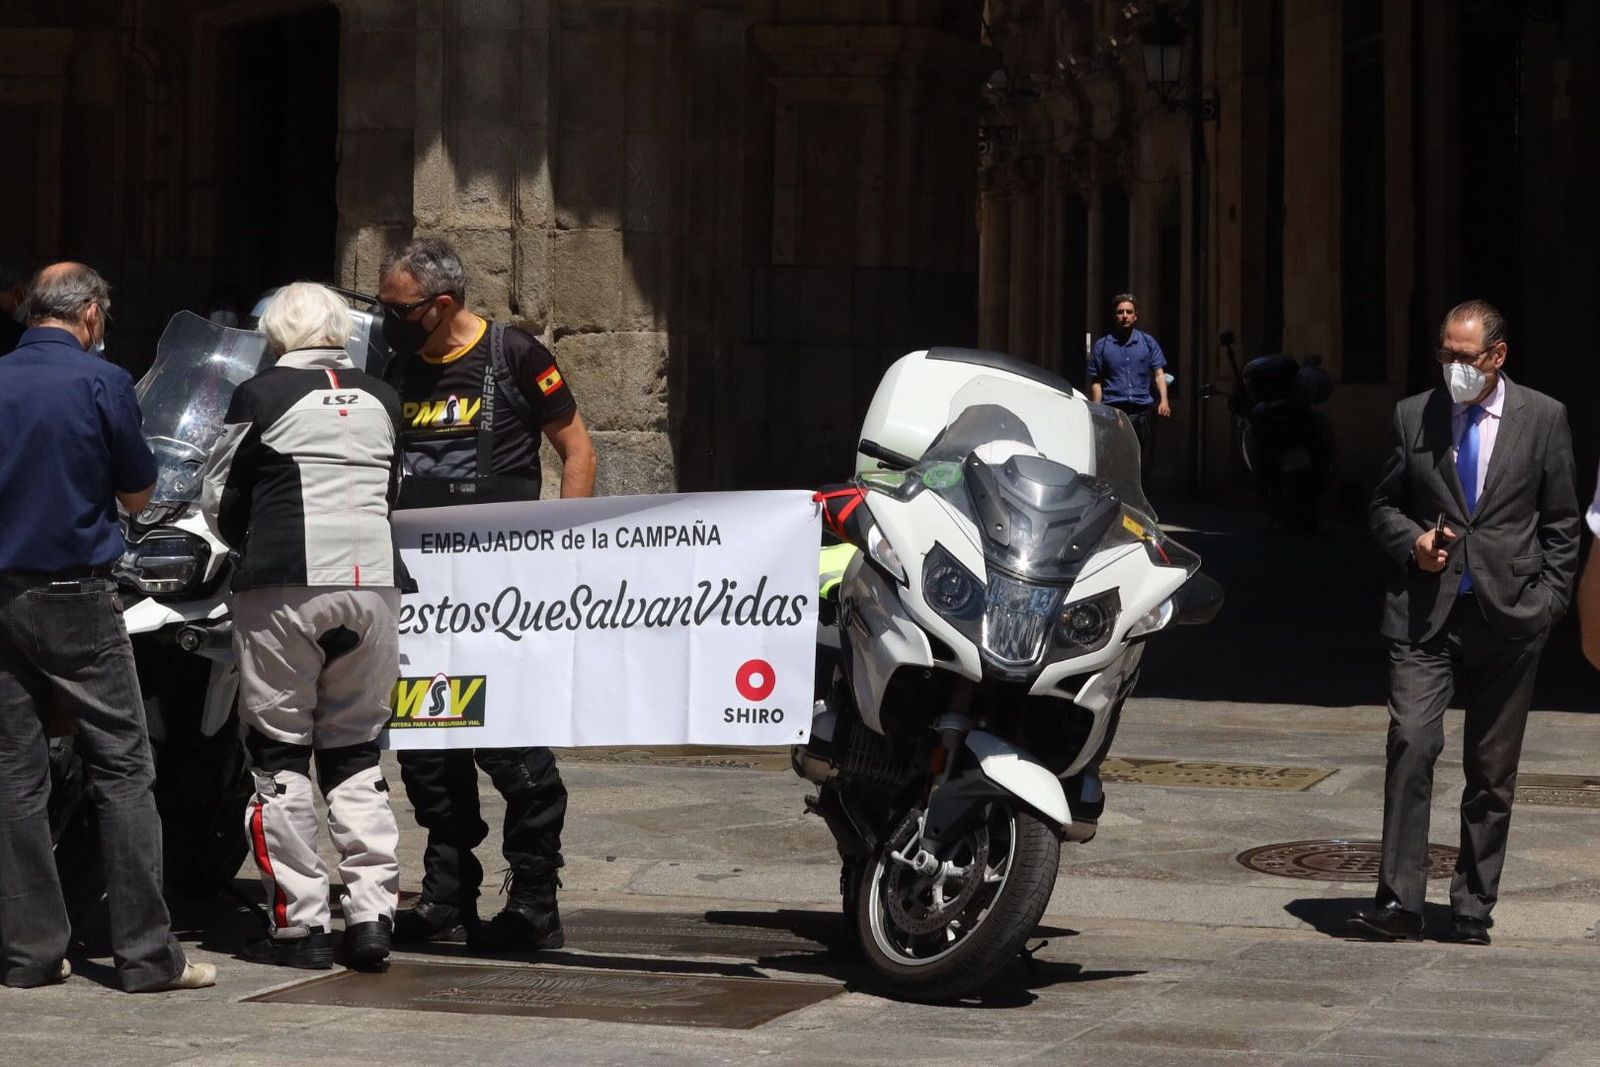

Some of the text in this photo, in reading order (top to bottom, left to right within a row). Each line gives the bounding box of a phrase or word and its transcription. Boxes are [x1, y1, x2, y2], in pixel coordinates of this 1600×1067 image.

[322, 394, 360, 406] LS2
[420, 520, 722, 554] EMBAJADOR de la CAMPAÑA
[399, 575, 808, 642] estosQueSalvanVidas
[391, 677, 485, 718] MSV
[723, 707, 785, 724] SHIRO
